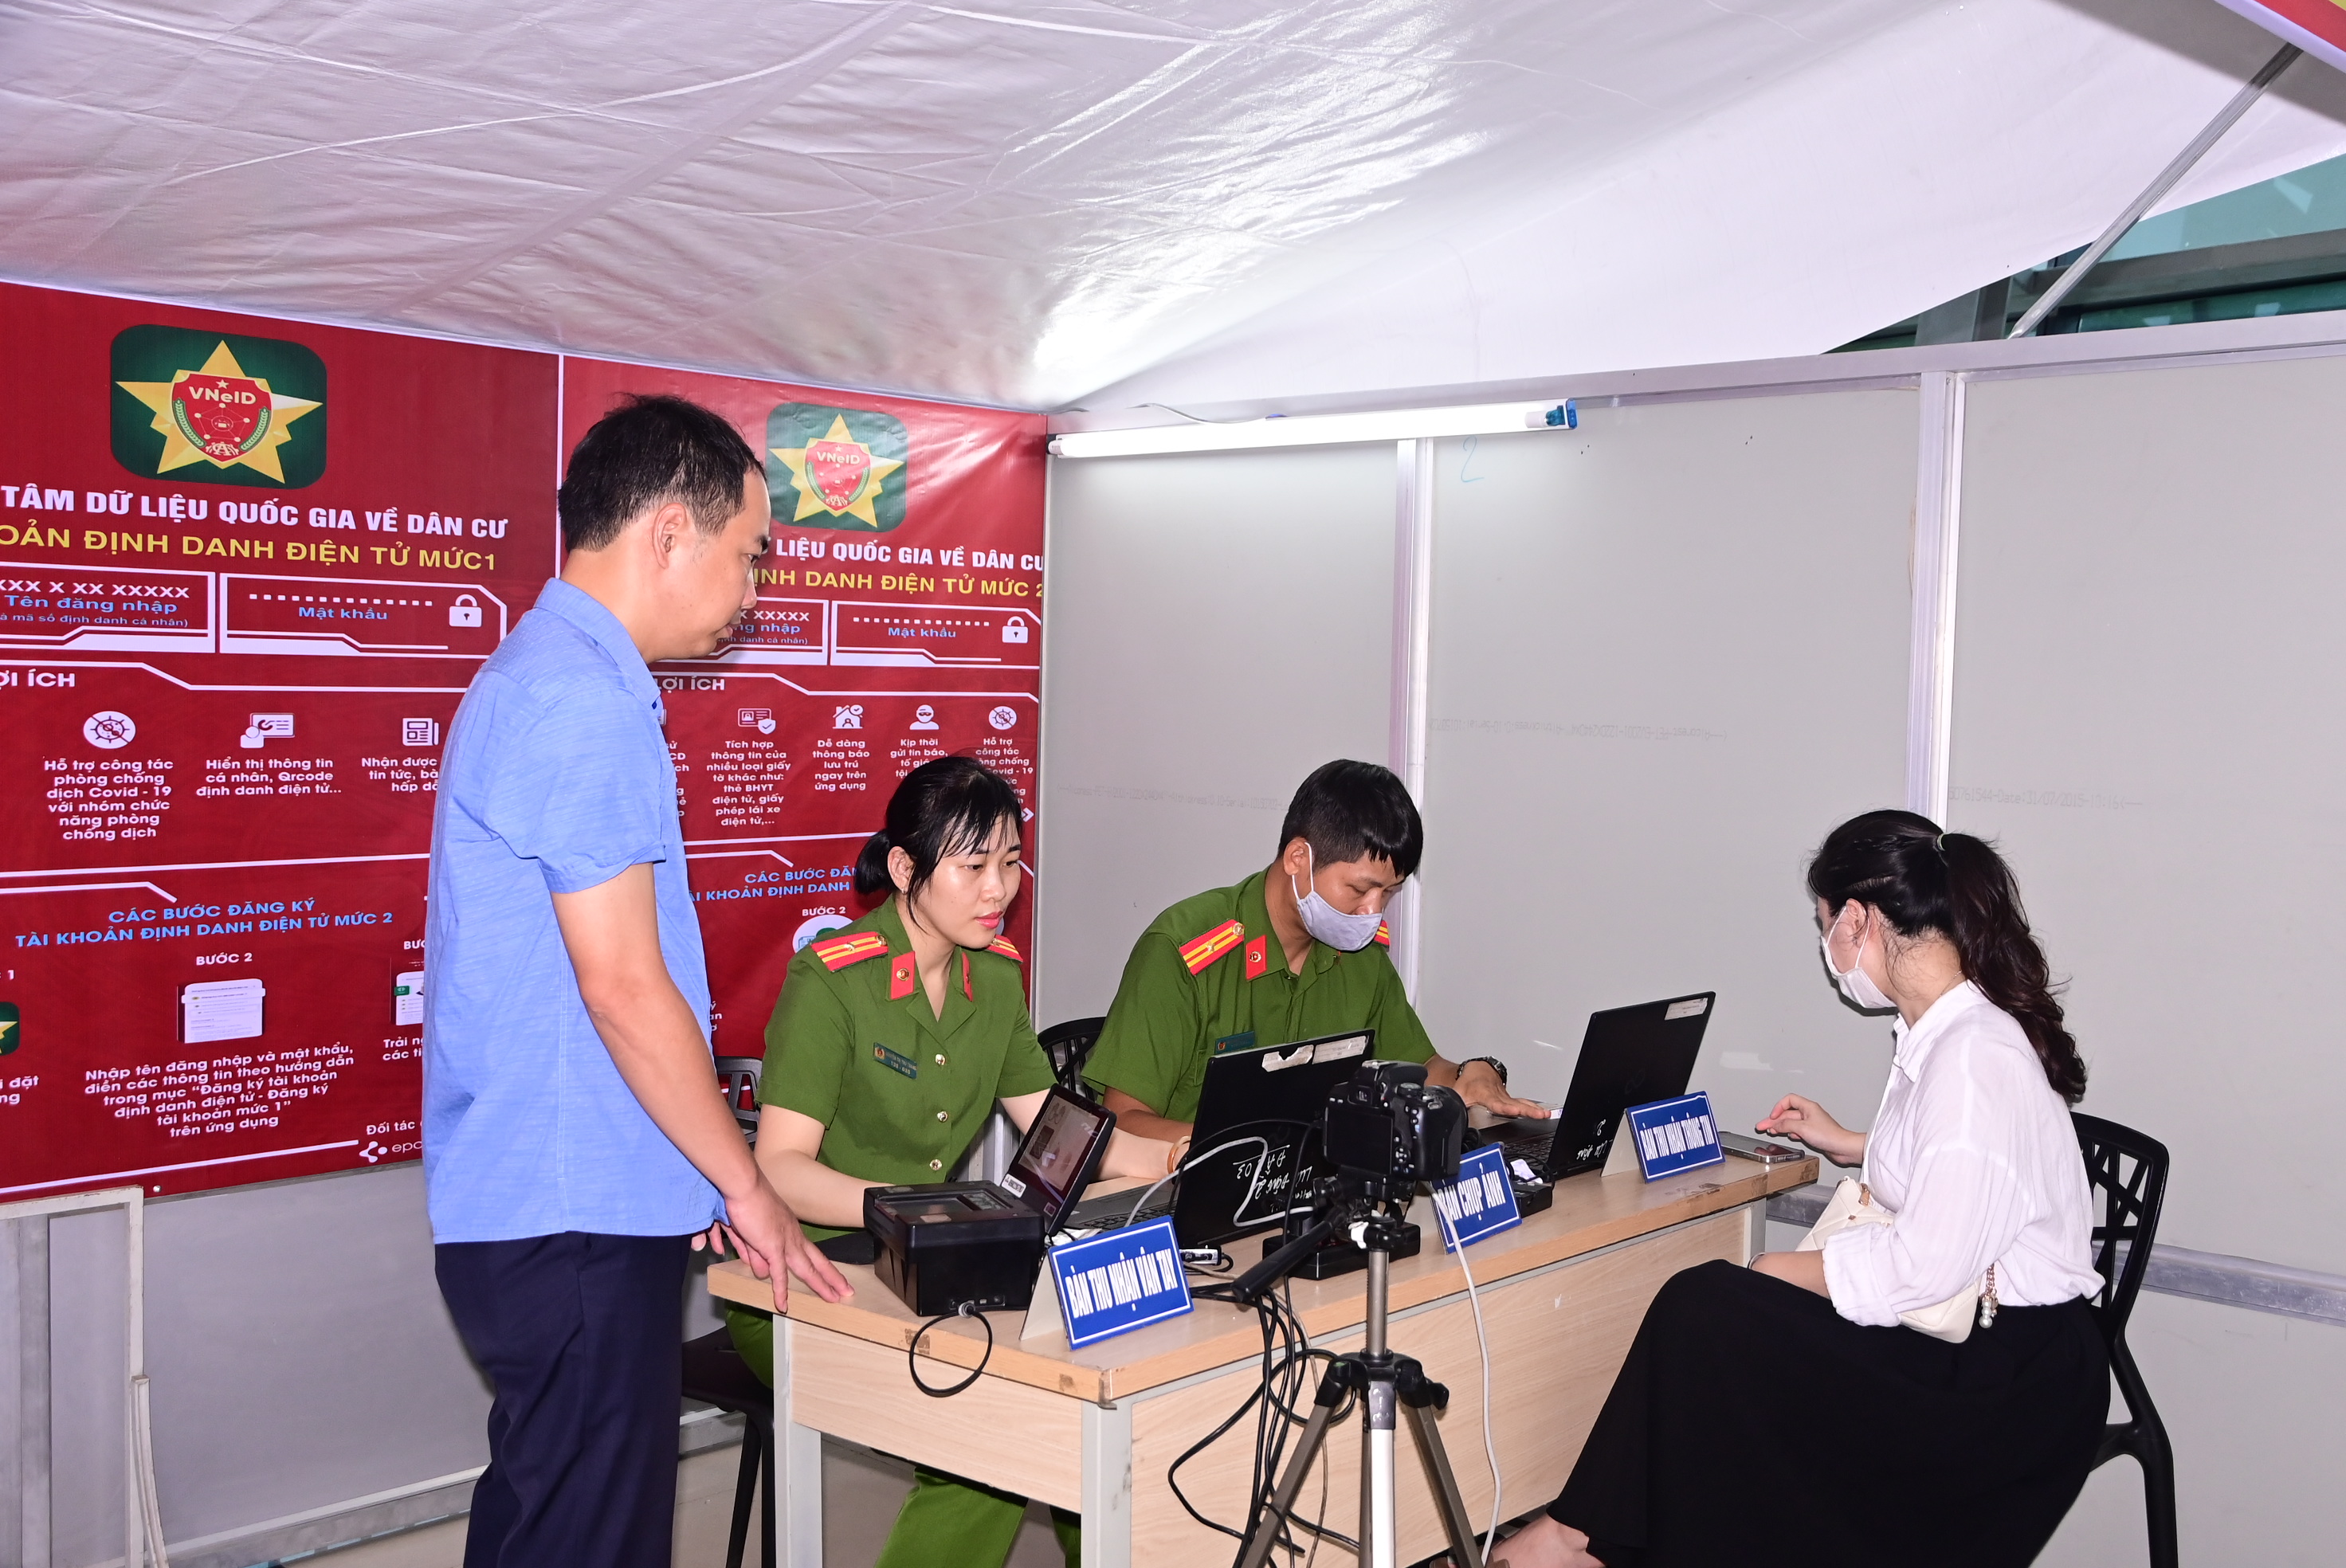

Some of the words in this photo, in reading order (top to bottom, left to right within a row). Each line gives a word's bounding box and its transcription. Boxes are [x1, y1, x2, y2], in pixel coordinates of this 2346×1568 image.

[189, 386, 256, 408] VNeID
[816, 450, 861, 465] VNeID
[1460, 436, 1485, 483] 2
[1, 483, 74, 511] TÂM
[87, 490, 133, 515] DỮ
[141, 494, 207, 523] LIỆU
[219, 498, 298, 526] QUỐC
[309, 508, 356, 529] GIA
[365, 507, 398, 532] VỀ
[407, 512, 462, 536] DÂN
[472, 519, 508, 539] CƯ
[84, 531, 168, 555] ĐỊNH
[182, 536, 273, 559] DANH
[286, 539, 359, 566] ĐIỆN
[370, 541, 410, 566] TỬ
[776, 537, 826, 561] LIỆU
[833, 539, 891, 563] QUỐC
[899, 547, 933, 565] GIA
[940, 546, 964, 566] VỀ
[972, 549, 1014, 569] DÂN
[806, 571, 872, 589] DANH
[881, 573, 934, 594] ĐIỆN
[943, 574, 975, 594] TỬ
[981, 578, 1029, 596] MỨC
[4, 595, 48, 607] Tên
[57, 598, 113, 613] đăng
[123, 600, 177, 614] nhập
[38, 613, 55, 622] số
[60, 615, 89, 625] định
[151, 618, 188, 628] nhân)
[299, 607, 334, 620] Mật
[341, 607, 387, 620] khẩu
[761, 623, 800, 634] nhập
[889, 627, 915, 638] Mật
[920, 627, 955, 637] khẩu
[28, 668, 75, 687] ÍCH
[691, 676, 725, 691] ÍCH
[752, 740, 774, 750] hợp
[818, 739, 833, 747] Dễ
[836, 739, 865, 749] dàng
[900, 739, 916, 747] Kịp
[999, 738, 1012, 747] trợ
[711, 751, 744, 761] thông
[765, 750, 787, 759] của
[812, 750, 845, 759] thông
[890, 748, 906, 759] gửi
[924, 748, 947, 757] báo,
[998, 756, 1030, 766] chống
[45, 758, 68, 770] Hỗ
[73, 760, 95, 773] trợ
[100, 759, 142, 772] công
[147, 759, 173, 769] tác
[206, 756, 241, 769] Hiển
[245, 759, 264, 771] thị
[268, 758, 311, 770] thông
[316, 759, 333, 767] tin
[54, 774, 108, 786] phòng
[113, 771, 164, 786] chống
[206, 772, 226, 782] cá
[231, 772, 273, 783] nhân,
[278, 771, 333, 782] Qrcode
[47, 788, 84, 801] dịch
[89, 786, 138, 798] Covid
[154, 786, 171, 796] 19
[196, 786, 230, 798] định
[235, 785, 273, 795] danh
[278, 784, 311, 796] điện
[315, 782, 341, 793] tử...
[49, 802, 73, 813] với
[79, 800, 125, 812] nhóm
[130, 799, 170, 810] chức
[60, 815, 102, 827] năng
[108, 813, 159, 826] phòng
[63, 826, 116, 841] chống
[121, 827, 156, 840] dịch
[744, 870, 779, 884] CÁC
[785, 868, 826, 880] BƯỚC
[706, 885, 763, 900] KHOẢN
[767, 885, 803, 898] ĐỊNH
[808, 881, 849, 893] DANH
[108, 907, 156, 923] CÁC
[163, 904, 221, 919] BƯỚC
[227, 901, 285, 915] ĐĂNG
[292, 897, 315, 911] KÝ
[802, 906, 836, 916] BƯỚC
[15, 931, 48, 947] TÀI
[57, 926, 133, 945] KHOẢN
[140, 925, 190, 942] ĐỊNH
[197, 921, 252, 935] DANH
[259, 916, 301, 933] ĐIỆN
[308, 912, 330, 928] TỬ
[335, 911, 377, 926] MỨC
[382, 912, 392, 923] 2
[196, 952, 239, 966] BƯỚC
[245, 953, 252, 962] 2
[86, 1068, 131, 1080] Nhập
[135, 1064, 160, 1076] tên
[166, 1060, 207, 1072] đăng
[213, 1055, 252, 1068] nhập
[257, 1051, 275, 1062] và
[314, 1041, 353, 1056] khẩu,
[84, 1080, 120, 1094] điền
[127, 1077, 157, 1089] các
[163, 1073, 208, 1085] thông
[214, 1070, 232, 1080] tin
[236, 1064, 270, 1077] theo
[276, 1062, 321, 1073] hướng
[326, 1054, 354, 1067] dẫn
[104, 1094, 147, 1106] trong
[152, 1089, 186, 1101] mục
[247, 1077, 264, 1090] ký
[269, 1076, 288, 1086] tài
[293, 1070, 337, 1085] khoản
[115, 1105, 150, 1119] định
[155, 1098, 196, 1113] danh
[202, 1096, 235, 1107] điện
[240, 1091, 255, 1103] tử
[268, 1088, 308, 1099] Đăng
[313, 1083, 328, 1095] ký
[1640, 1123, 1659, 1161] BÀN
[1652, 1125, 1670, 1157] THU
[1664, 1115, 1687, 1160] NHẬN
[1680, 1111, 1705, 1151] THÔNG
[1699, 1114, 1716, 1146] TIN
[1457, 1177, 1484, 1221] CHỤP
[1479, 1162, 1506, 1209] ẢNH
[1065, 1264, 1094, 1319] BÀN
[1087, 1266, 1113, 1311] THU
[1107, 1252, 1142, 1311] NHẬN
[1135, 1246, 1163, 1297] VÂN
[1155, 1248, 1179, 1292] TAY
